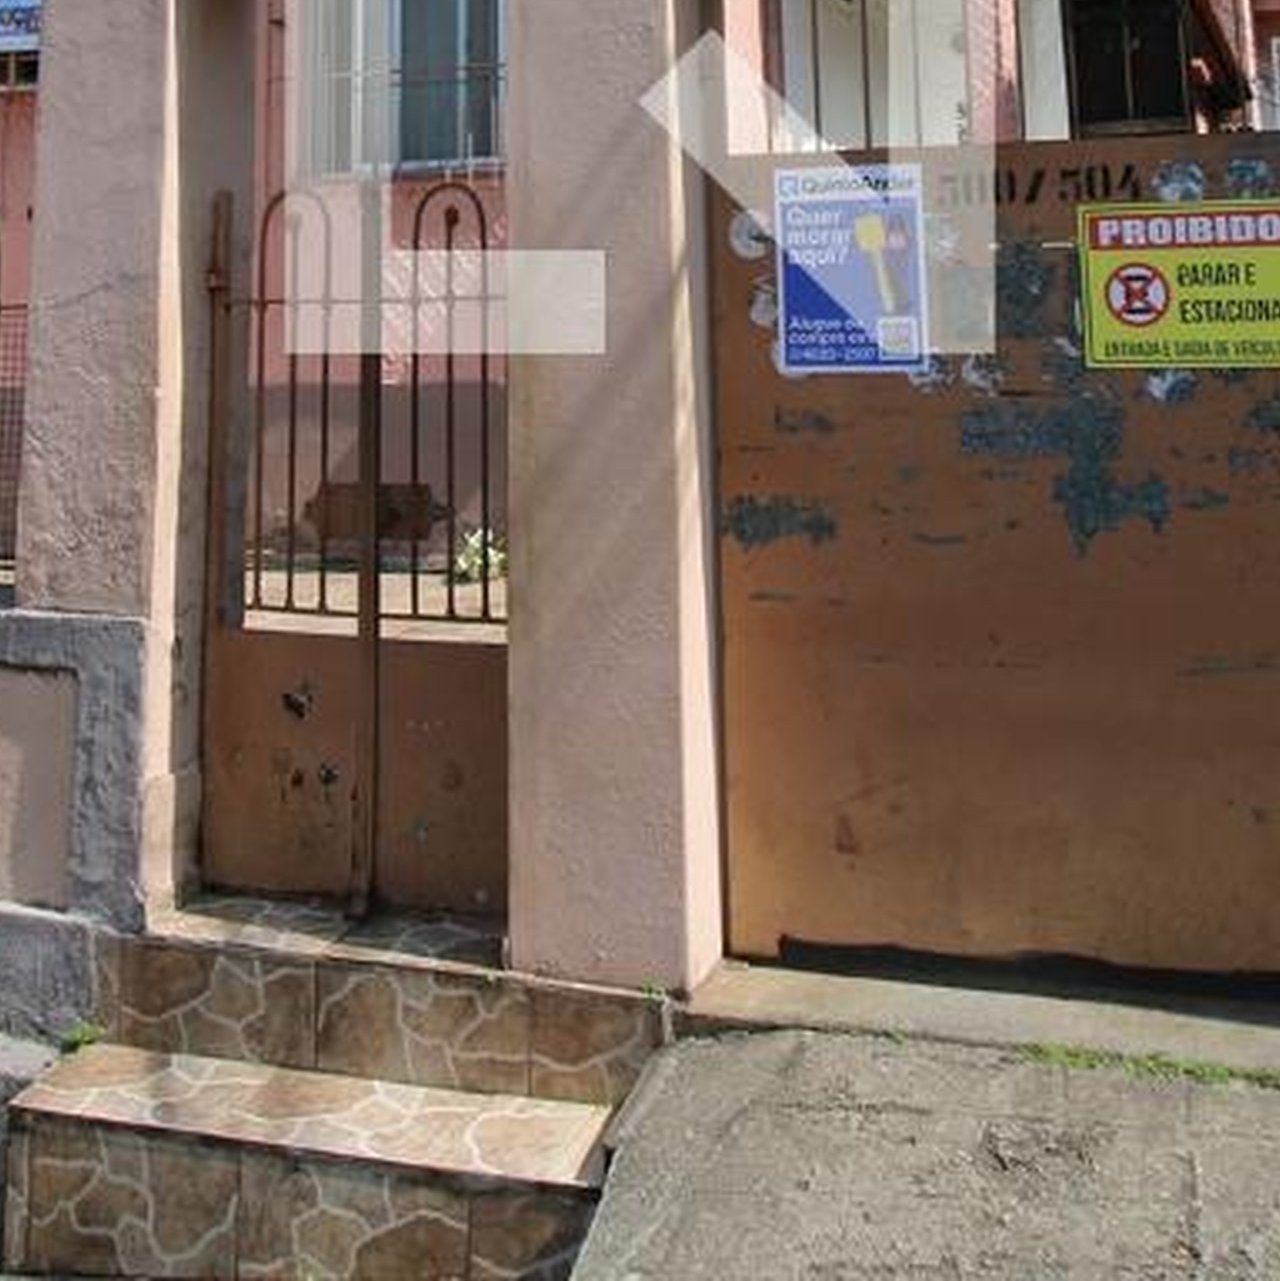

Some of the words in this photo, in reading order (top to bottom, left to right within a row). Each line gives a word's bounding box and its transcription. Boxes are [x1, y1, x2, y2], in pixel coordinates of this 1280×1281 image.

[786, 206, 842, 226] Quer
[1177, 264, 1241, 287] PARAR
[1245, 263, 1257, 285] E
